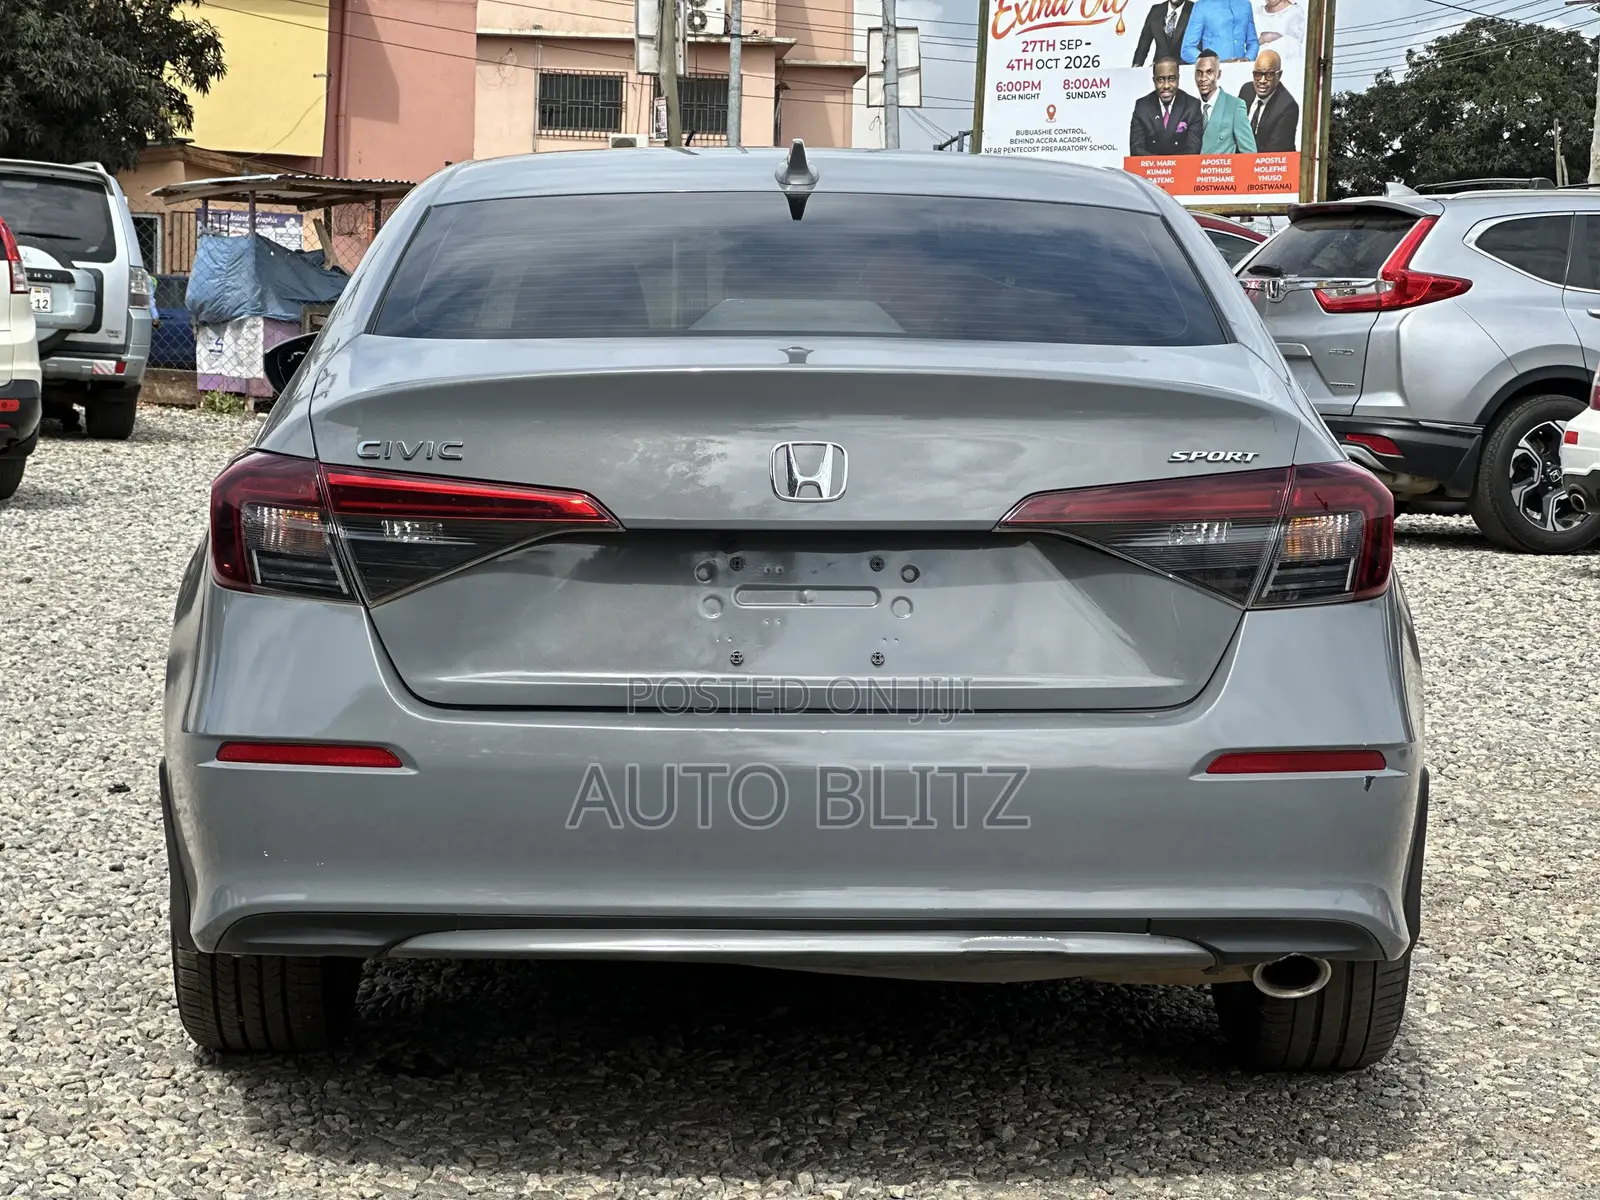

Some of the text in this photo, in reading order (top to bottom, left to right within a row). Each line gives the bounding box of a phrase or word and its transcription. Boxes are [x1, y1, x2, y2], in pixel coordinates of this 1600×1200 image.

[1021, 40, 1056, 52] 27TH
[1006, 55, 1100, 71] 4TH OCT 2026
[996, 80, 1041, 93] 6:00PM
[1063, 78, 1110, 90] 8:00AM
[997, 93, 1016, 101] EACH
[1066, 91, 1106, 100] SUNDAYS
[1193, 184, 1237, 192] (BOSTWANA)
[1247, 183, 1292, 192] (BOSTWANA)
[356, 440, 463, 460] CIVIC
[1167, 450, 1260, 463] SPORT
